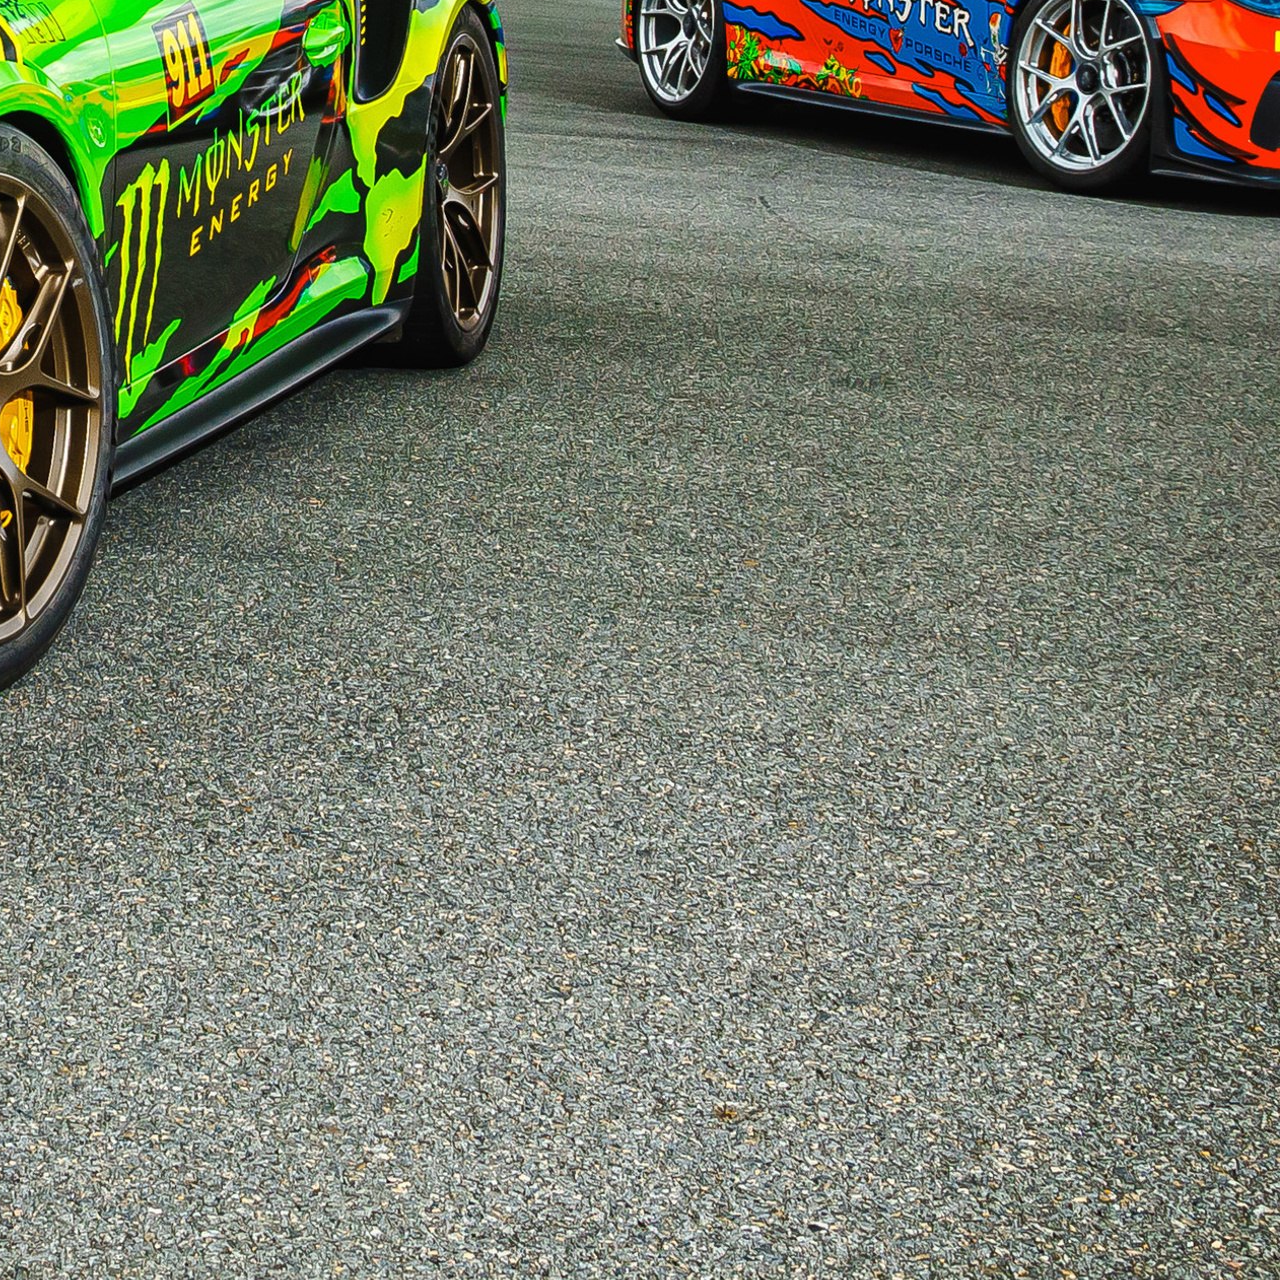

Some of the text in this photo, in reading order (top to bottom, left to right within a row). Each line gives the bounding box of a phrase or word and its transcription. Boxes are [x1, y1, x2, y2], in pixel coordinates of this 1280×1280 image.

[161, 12, 213, 108] 911
[834, 9, 972, 71] ENERGY PORSCHE
[10, 135, 22, 154] 2
[189, 148, 294, 258] ENERGY
